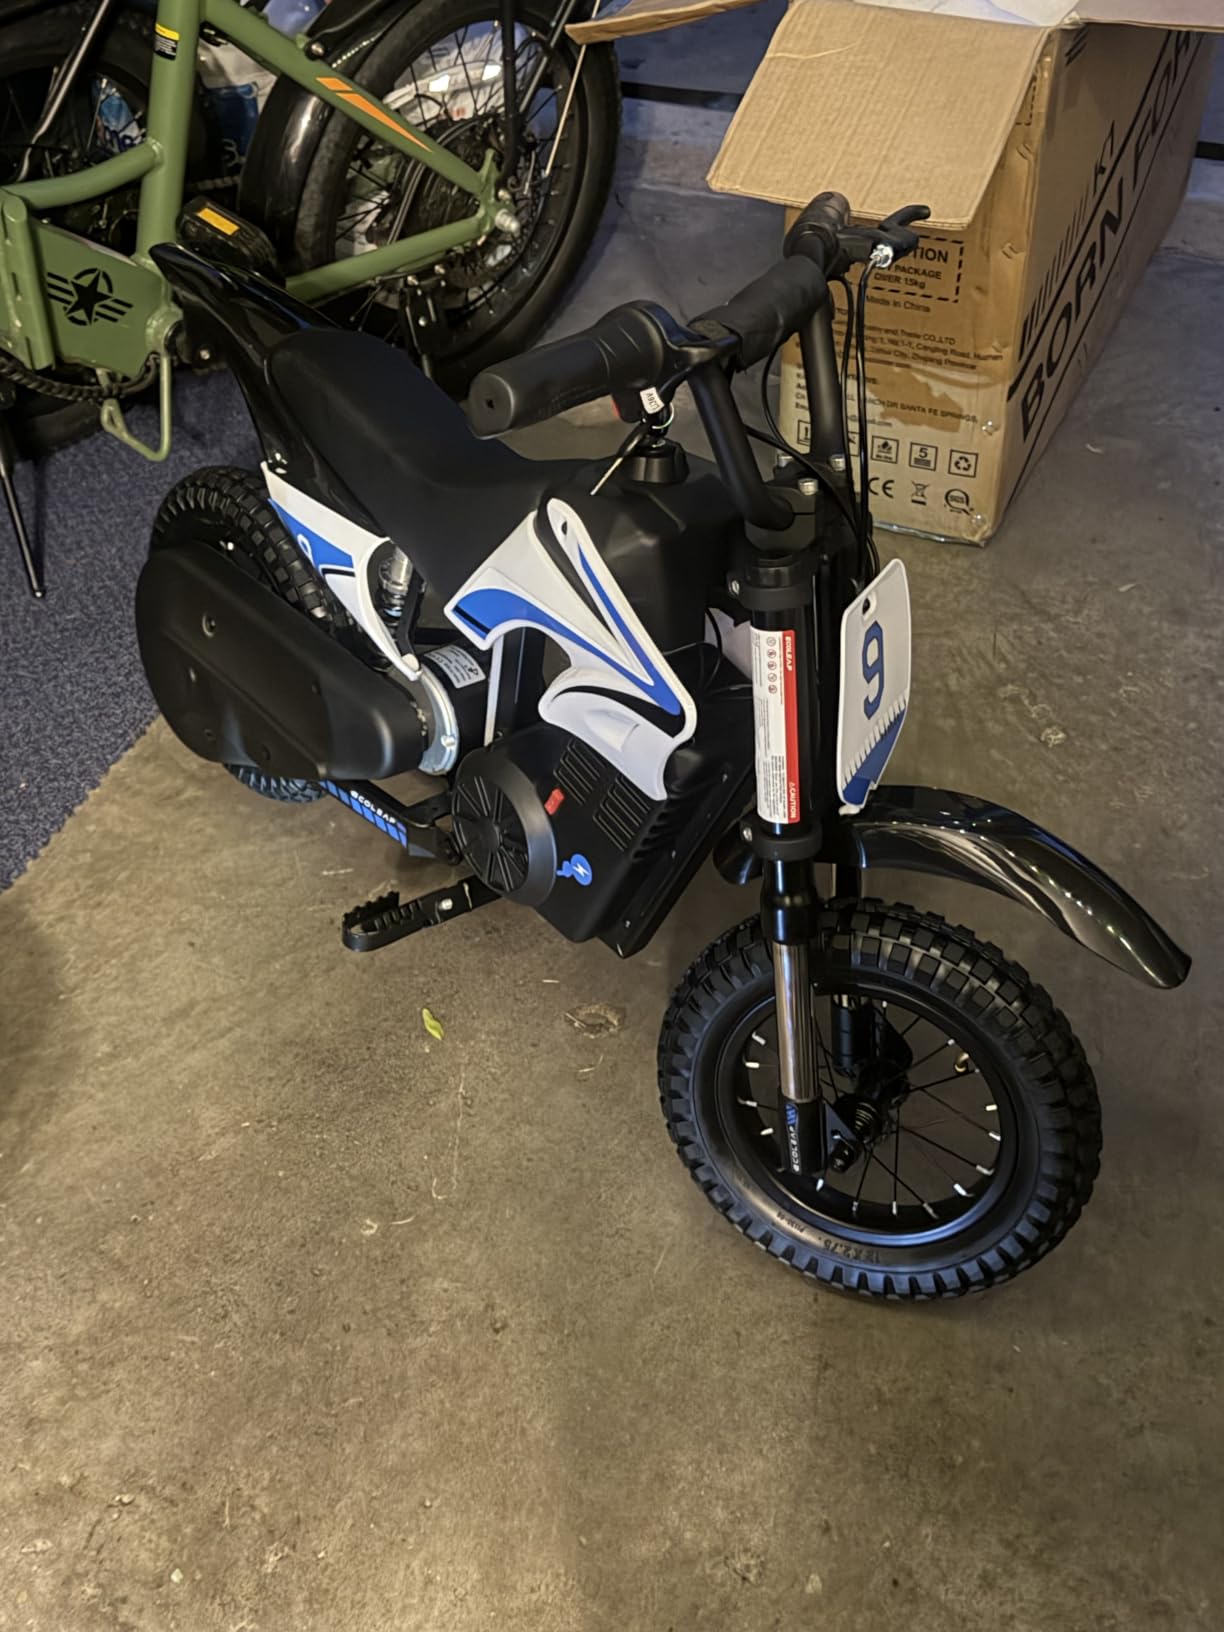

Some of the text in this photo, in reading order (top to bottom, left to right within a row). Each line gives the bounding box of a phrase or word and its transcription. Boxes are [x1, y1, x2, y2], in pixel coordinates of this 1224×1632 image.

[911, 247, 949, 263] TION
[894, 264, 942, 280] PACKAGE
[1020, 176, 1124, 442] BORN
[918, 447, 929, 459] 5
[861, 620, 884, 721] 9
